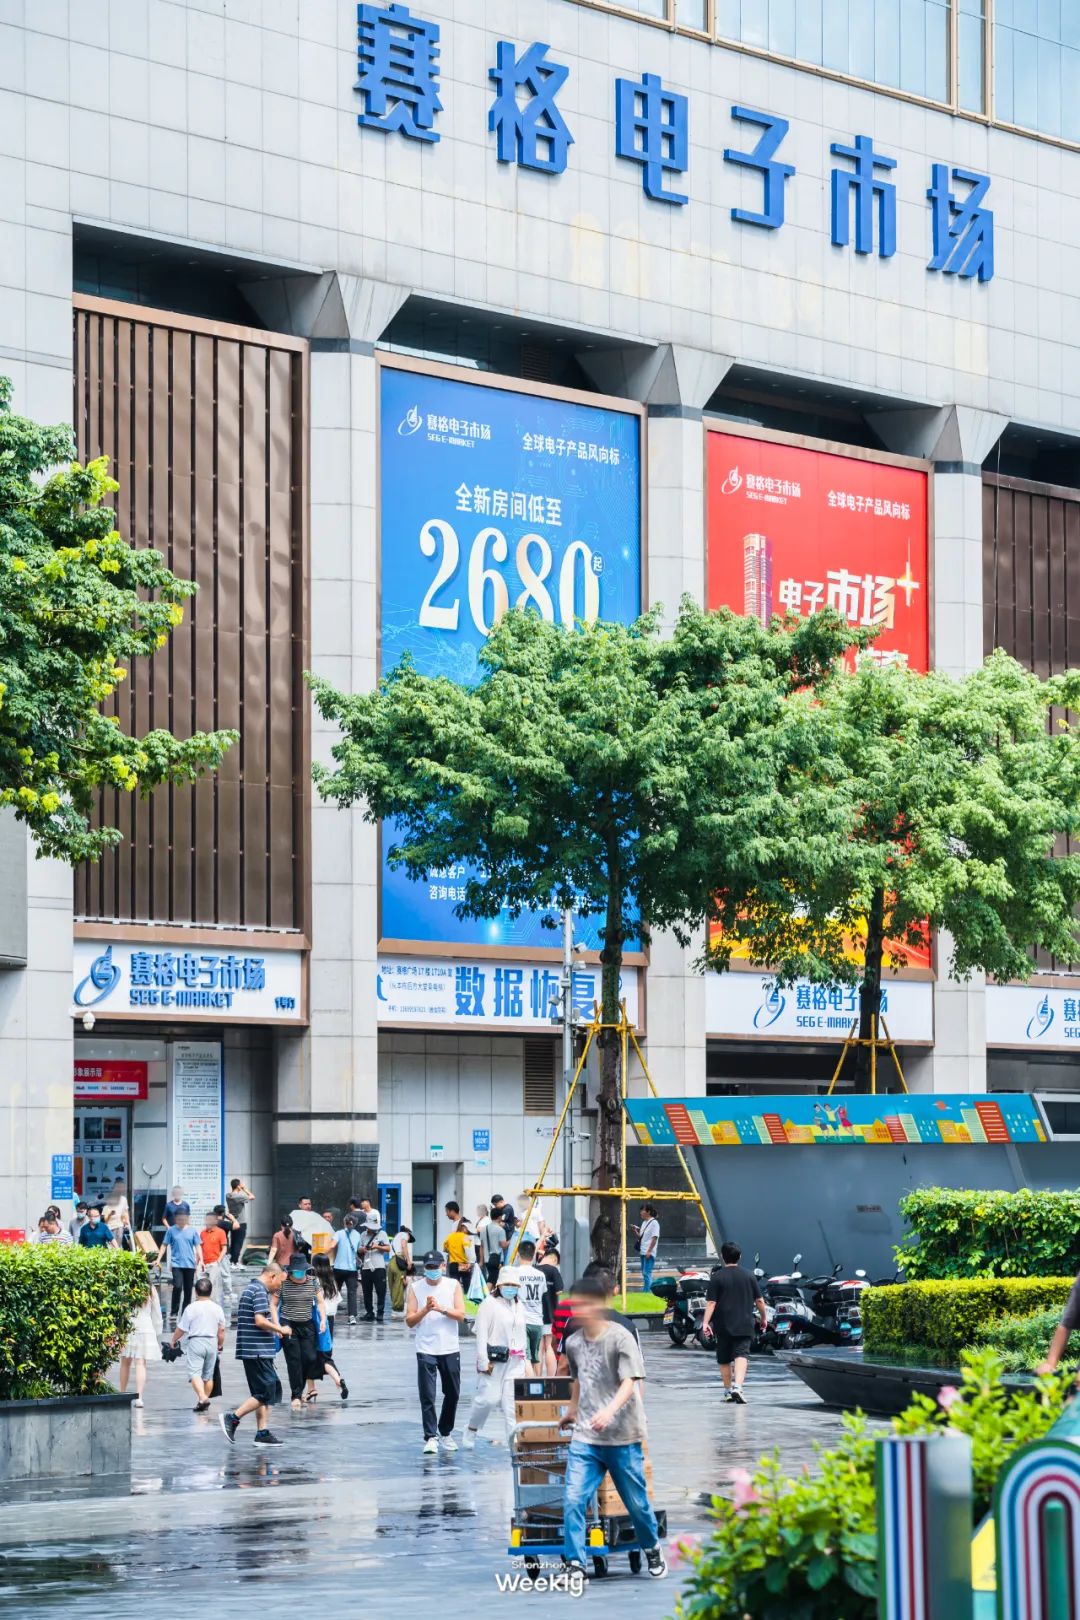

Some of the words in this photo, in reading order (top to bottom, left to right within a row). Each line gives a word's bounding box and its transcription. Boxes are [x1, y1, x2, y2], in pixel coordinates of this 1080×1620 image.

[353, 3, 995, 283] 赛格电子市场
[427, 414, 491, 441] 赛格电子市场
[522, 432, 620, 465] 全球电子产品风向标
[746, 473, 801, 498] 赛格电子市场
[455, 482, 562, 527] 全新房间低至
[827, 490, 911, 521] 全球电子产品风向标
[419, 518, 600, 638] 2680
[429, 885, 466, 902] 咨询电话
[129, 951, 267, 991] 赛格电子市场
[129, 989, 159, 1007] SEG
[455, 966, 596, 1020] 数据恢复
[796, 983, 889, 1013] 赛格电子场
[796, 1015, 816, 1029] SEG
[817, 1016, 860, 1031] E-MARK
[1063, 997, 1080, 1022] 赛
[525, 1284, 540, 1301] M
